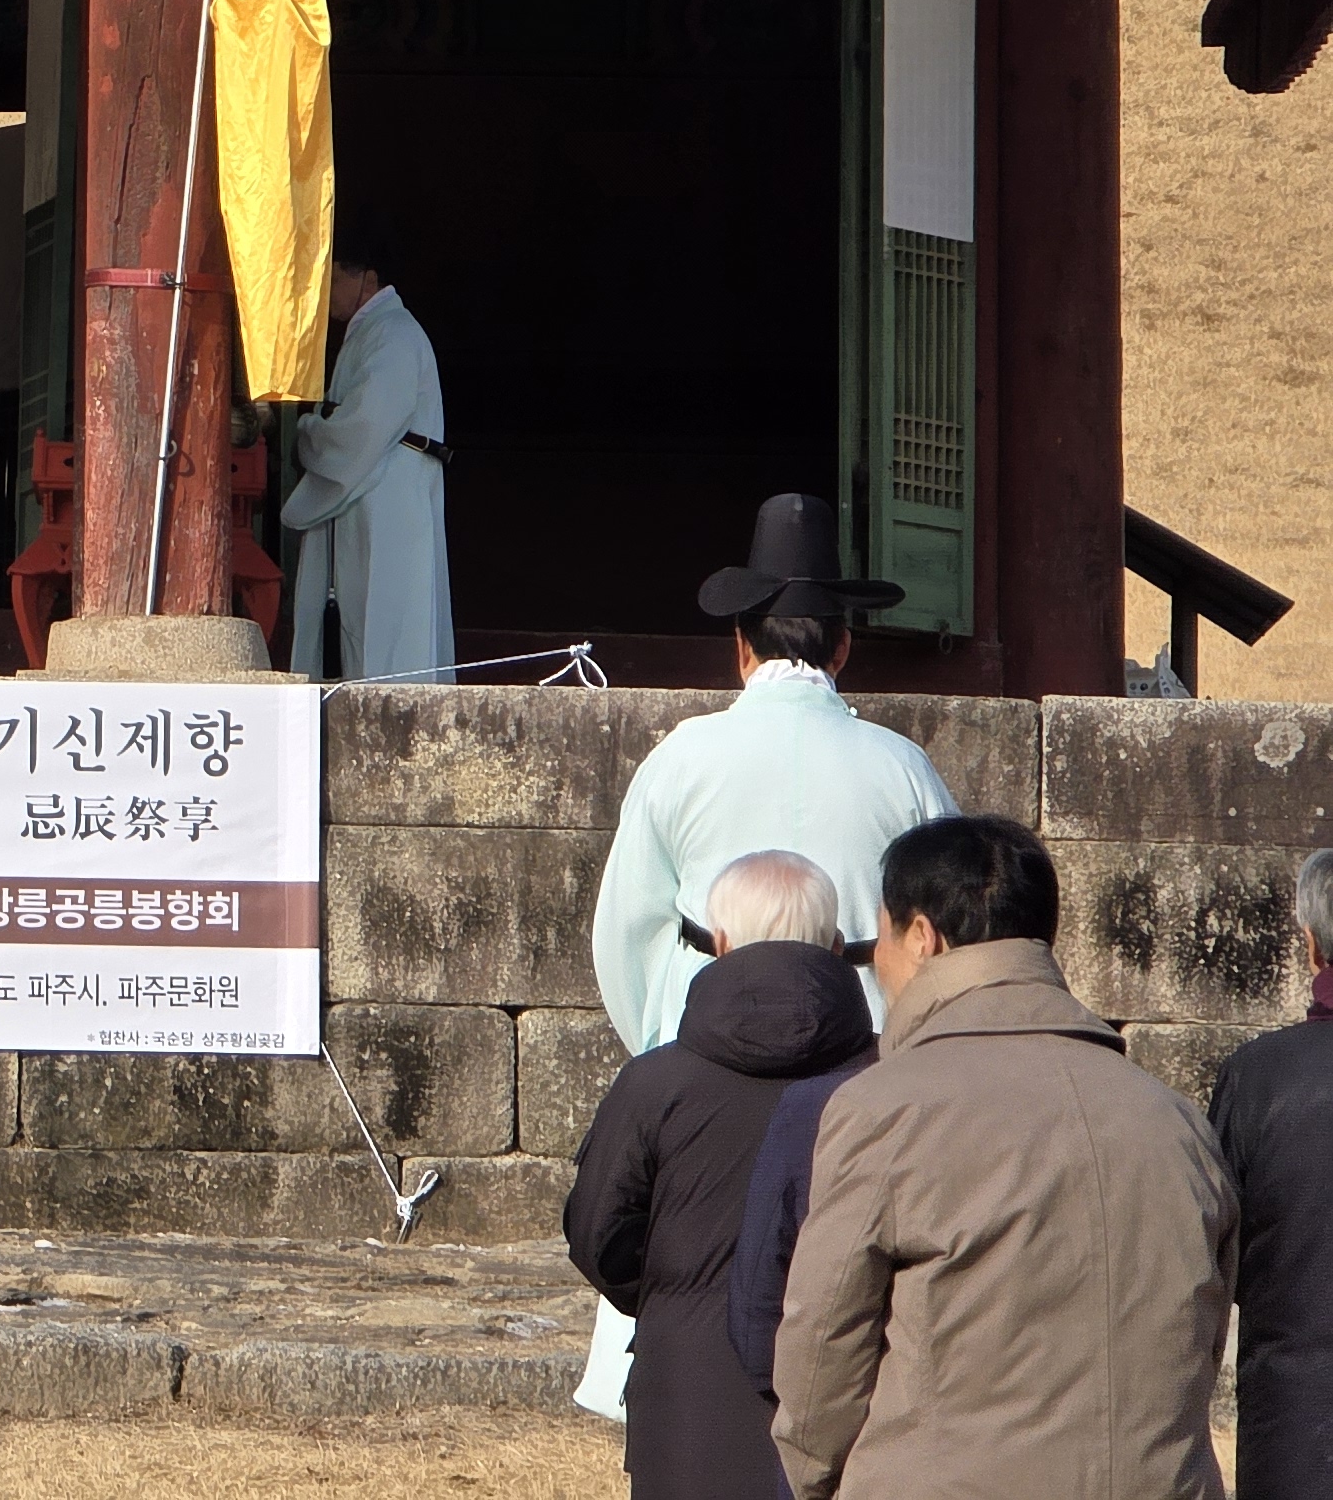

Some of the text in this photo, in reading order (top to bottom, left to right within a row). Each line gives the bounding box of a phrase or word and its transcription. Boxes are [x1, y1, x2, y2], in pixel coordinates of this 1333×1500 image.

[20, 793, 220, 843] 忌辰祭享
[117, 973, 240, 1009] 파주문화원
